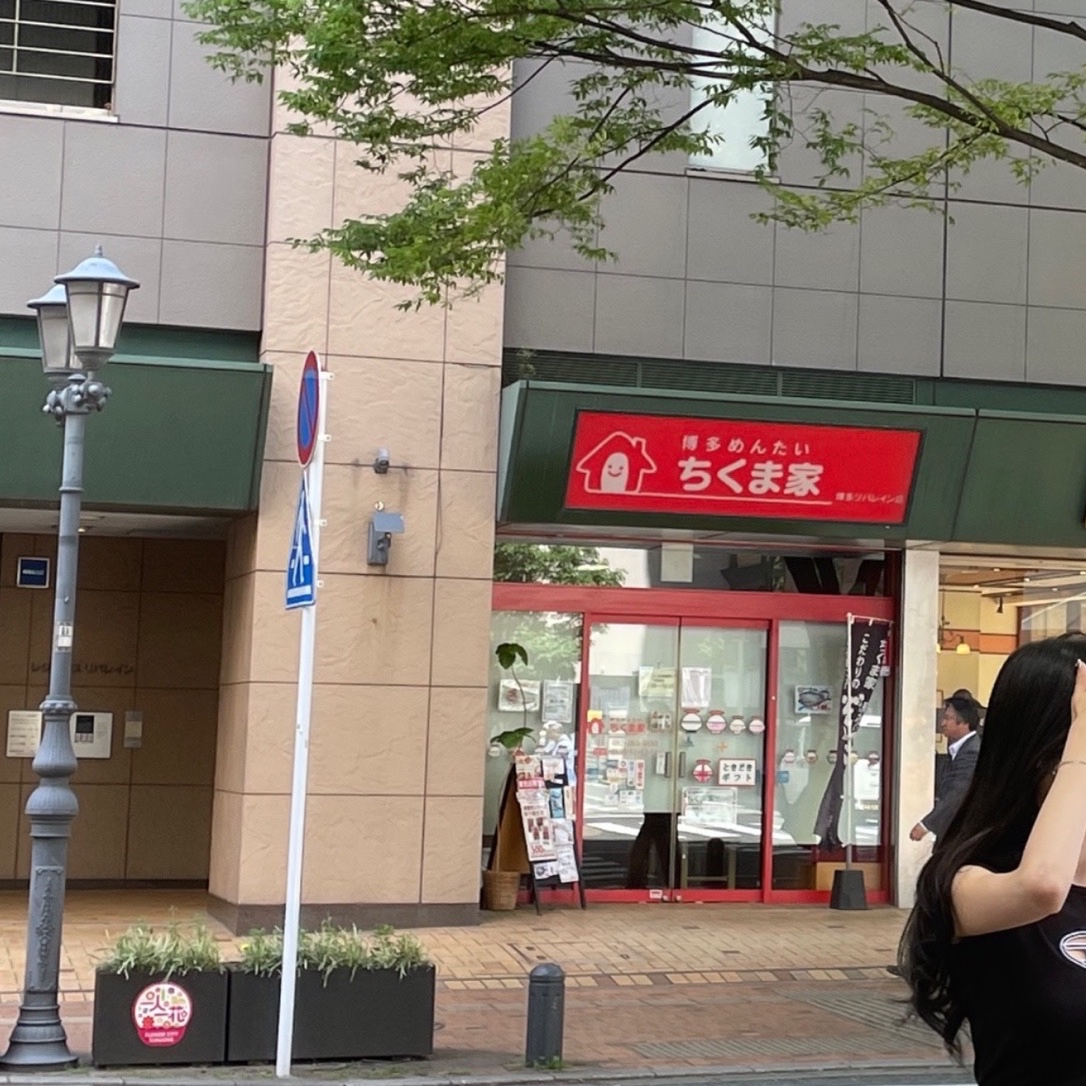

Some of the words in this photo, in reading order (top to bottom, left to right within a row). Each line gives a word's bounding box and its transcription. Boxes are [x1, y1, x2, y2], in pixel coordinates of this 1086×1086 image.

[682, 434, 810, 456] 博多めんたい
[677, 455, 824, 497] ちくま家
